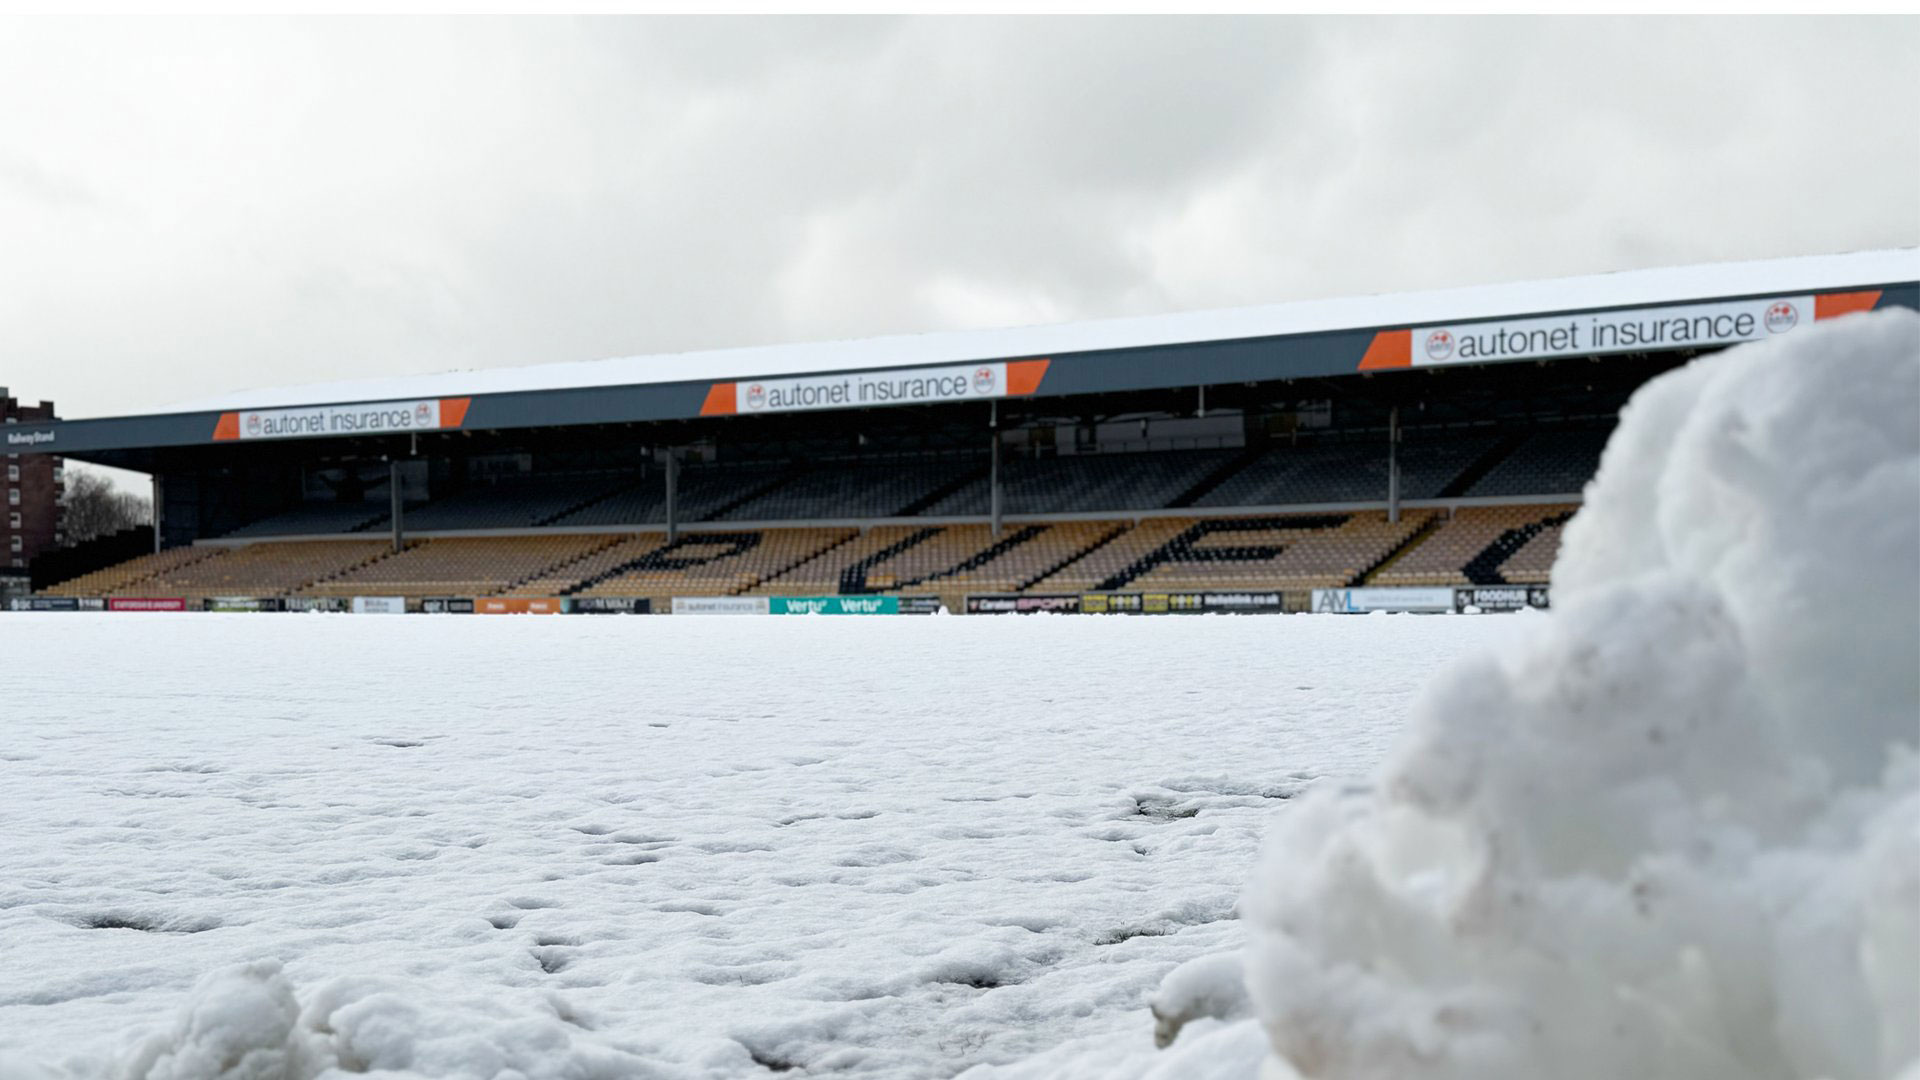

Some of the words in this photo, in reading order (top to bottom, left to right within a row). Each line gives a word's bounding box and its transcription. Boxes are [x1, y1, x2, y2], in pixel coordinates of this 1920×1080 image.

[1459, 322, 1579, 358] autonet
[1592, 312, 1755, 348] insurance
[769, 381, 850, 408] autonet
[858, 376, 967, 401] insurance
[264, 411, 325, 435] autonet
[330, 408, 411, 432] insurance
[1318, 590, 1359, 611] AML
